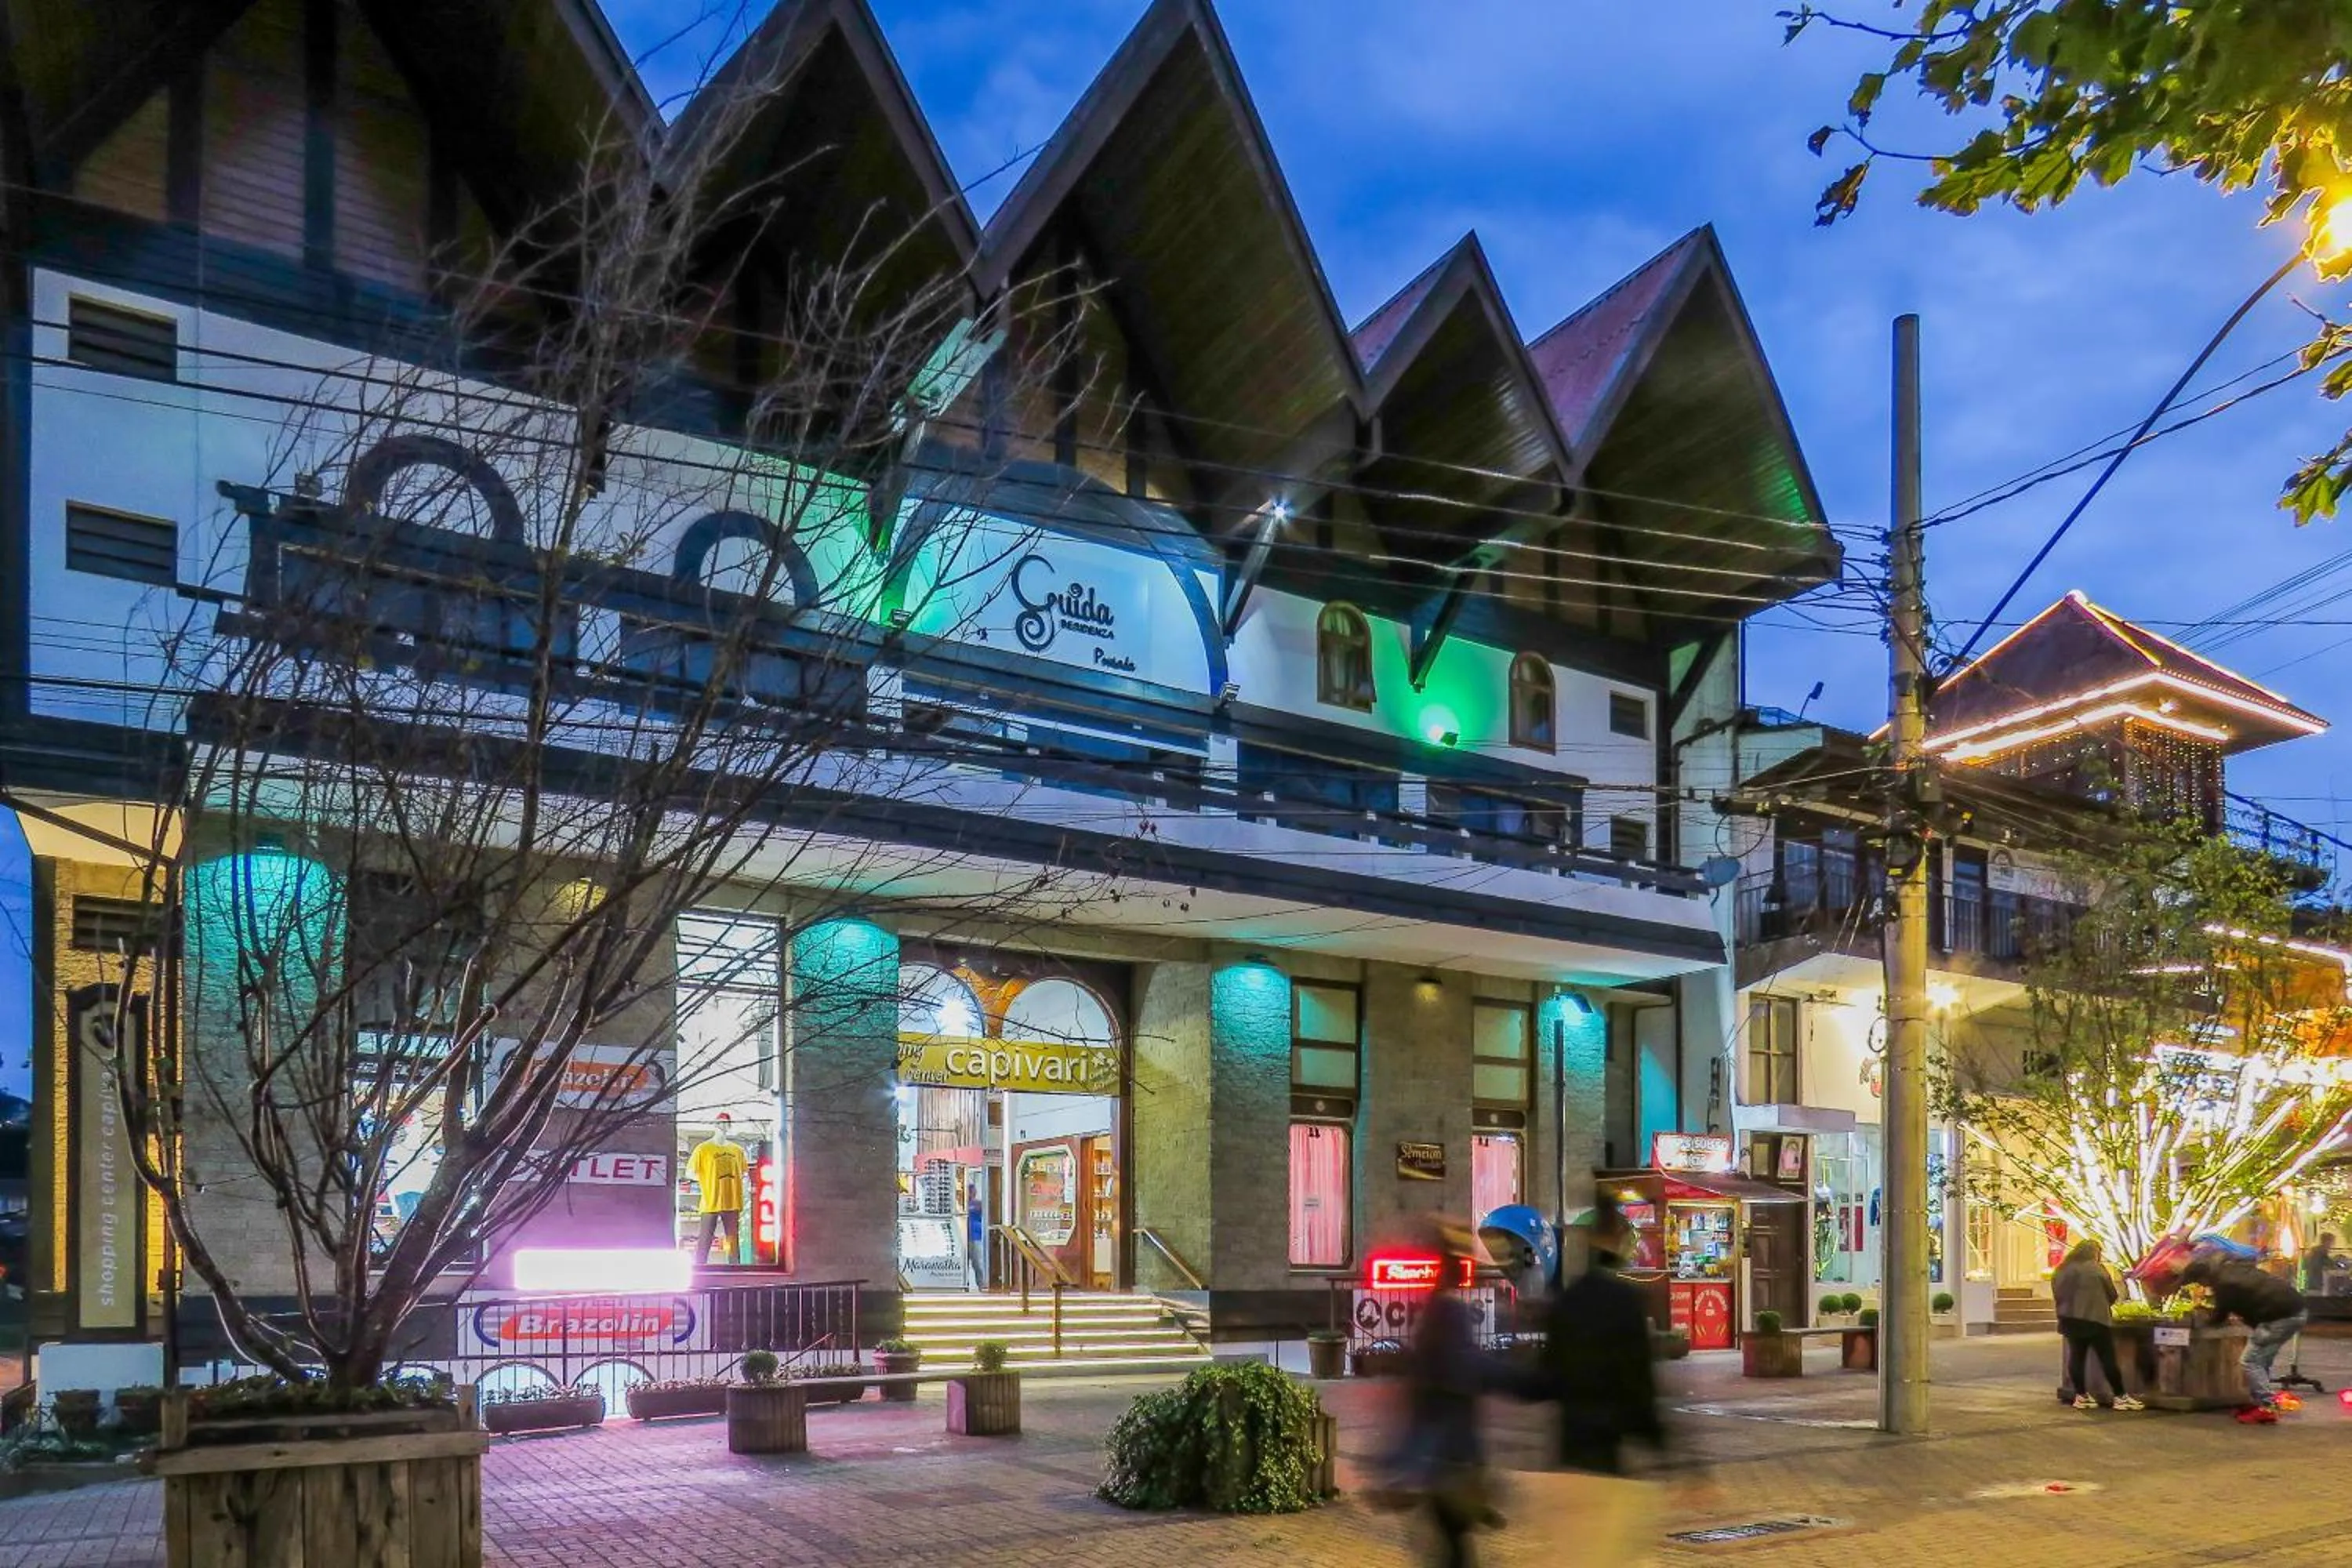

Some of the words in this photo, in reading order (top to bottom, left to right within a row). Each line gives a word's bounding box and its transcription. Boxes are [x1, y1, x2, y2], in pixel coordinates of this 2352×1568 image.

[946, 1047, 1088, 1085] capivari
[100, 1143, 115, 1206] center
[100, 1212, 119, 1307] shopping
[517, 1314, 660, 1336] Brazolin
